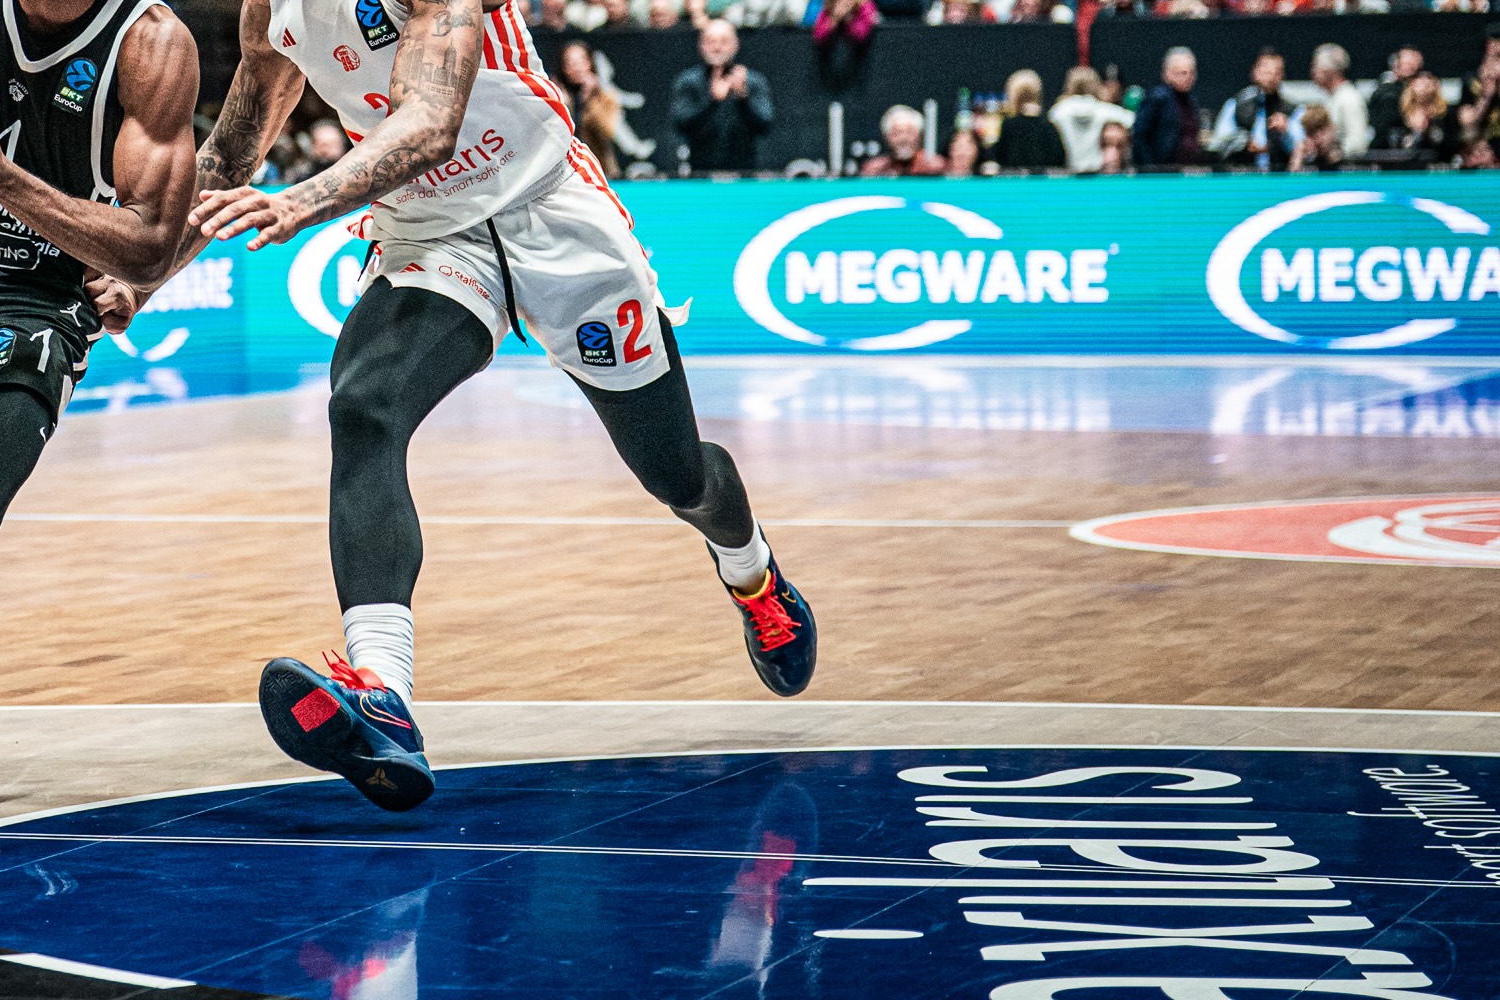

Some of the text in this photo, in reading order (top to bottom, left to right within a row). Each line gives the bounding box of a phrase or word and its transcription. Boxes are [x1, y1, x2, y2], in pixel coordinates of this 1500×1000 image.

[367, 25, 389, 39] BKT
[368, 32, 397, 47] EuroCup
[54, 94, 83, 112] EuroCup
[60, 87, 84, 101] BKT
[407, 128, 505, 187] ilaris
[396, 189, 415, 204] safe
[444, 177, 474, 197] smart
[785, 249, 1109, 304] MEGWARE
[617, 299, 652, 364] 2
[583, 356, 613, 364] EuroCup
